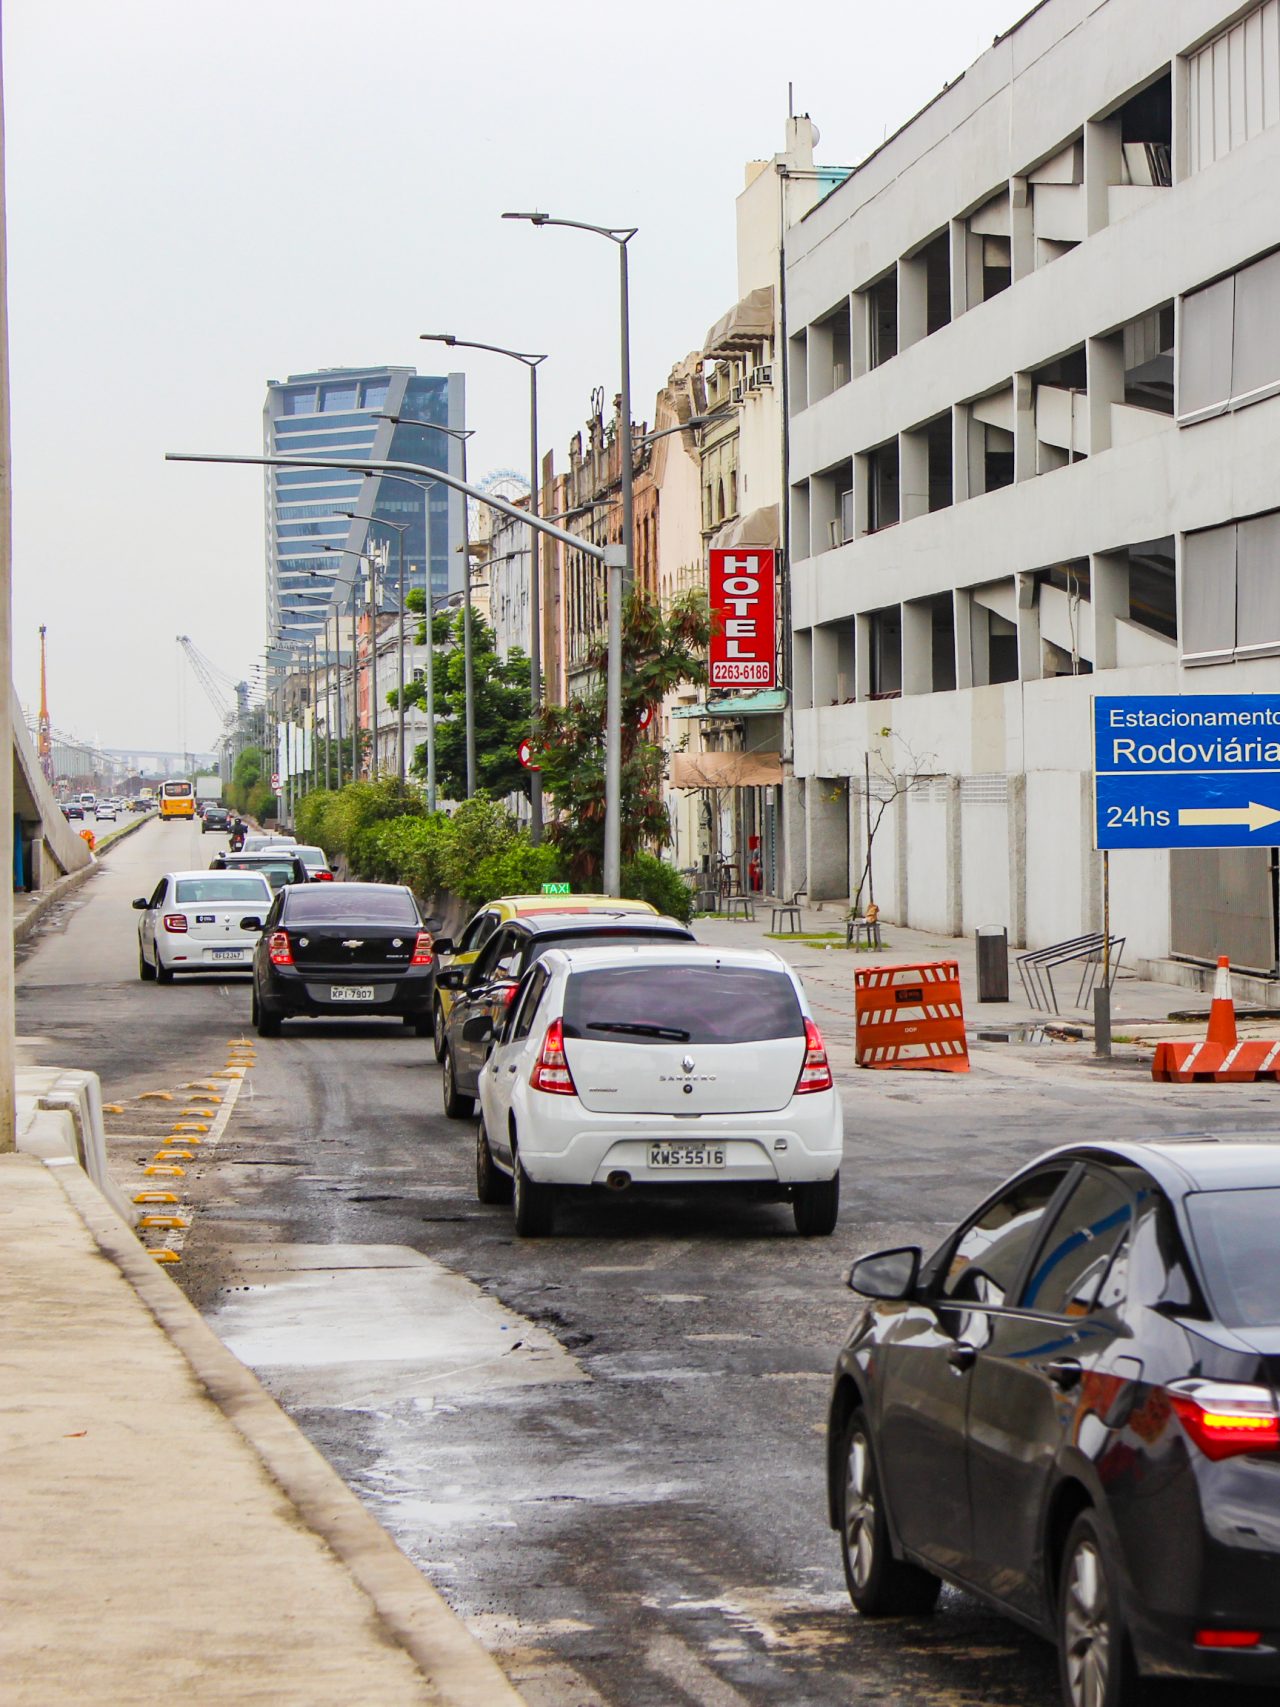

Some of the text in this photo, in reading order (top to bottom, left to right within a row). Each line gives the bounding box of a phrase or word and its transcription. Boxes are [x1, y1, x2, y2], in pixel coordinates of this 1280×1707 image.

[722, 556, 760, 658] HOTEL
[714, 664, 769, 680] 2263-6186
[1106, 805, 1171, 828] 24hs
